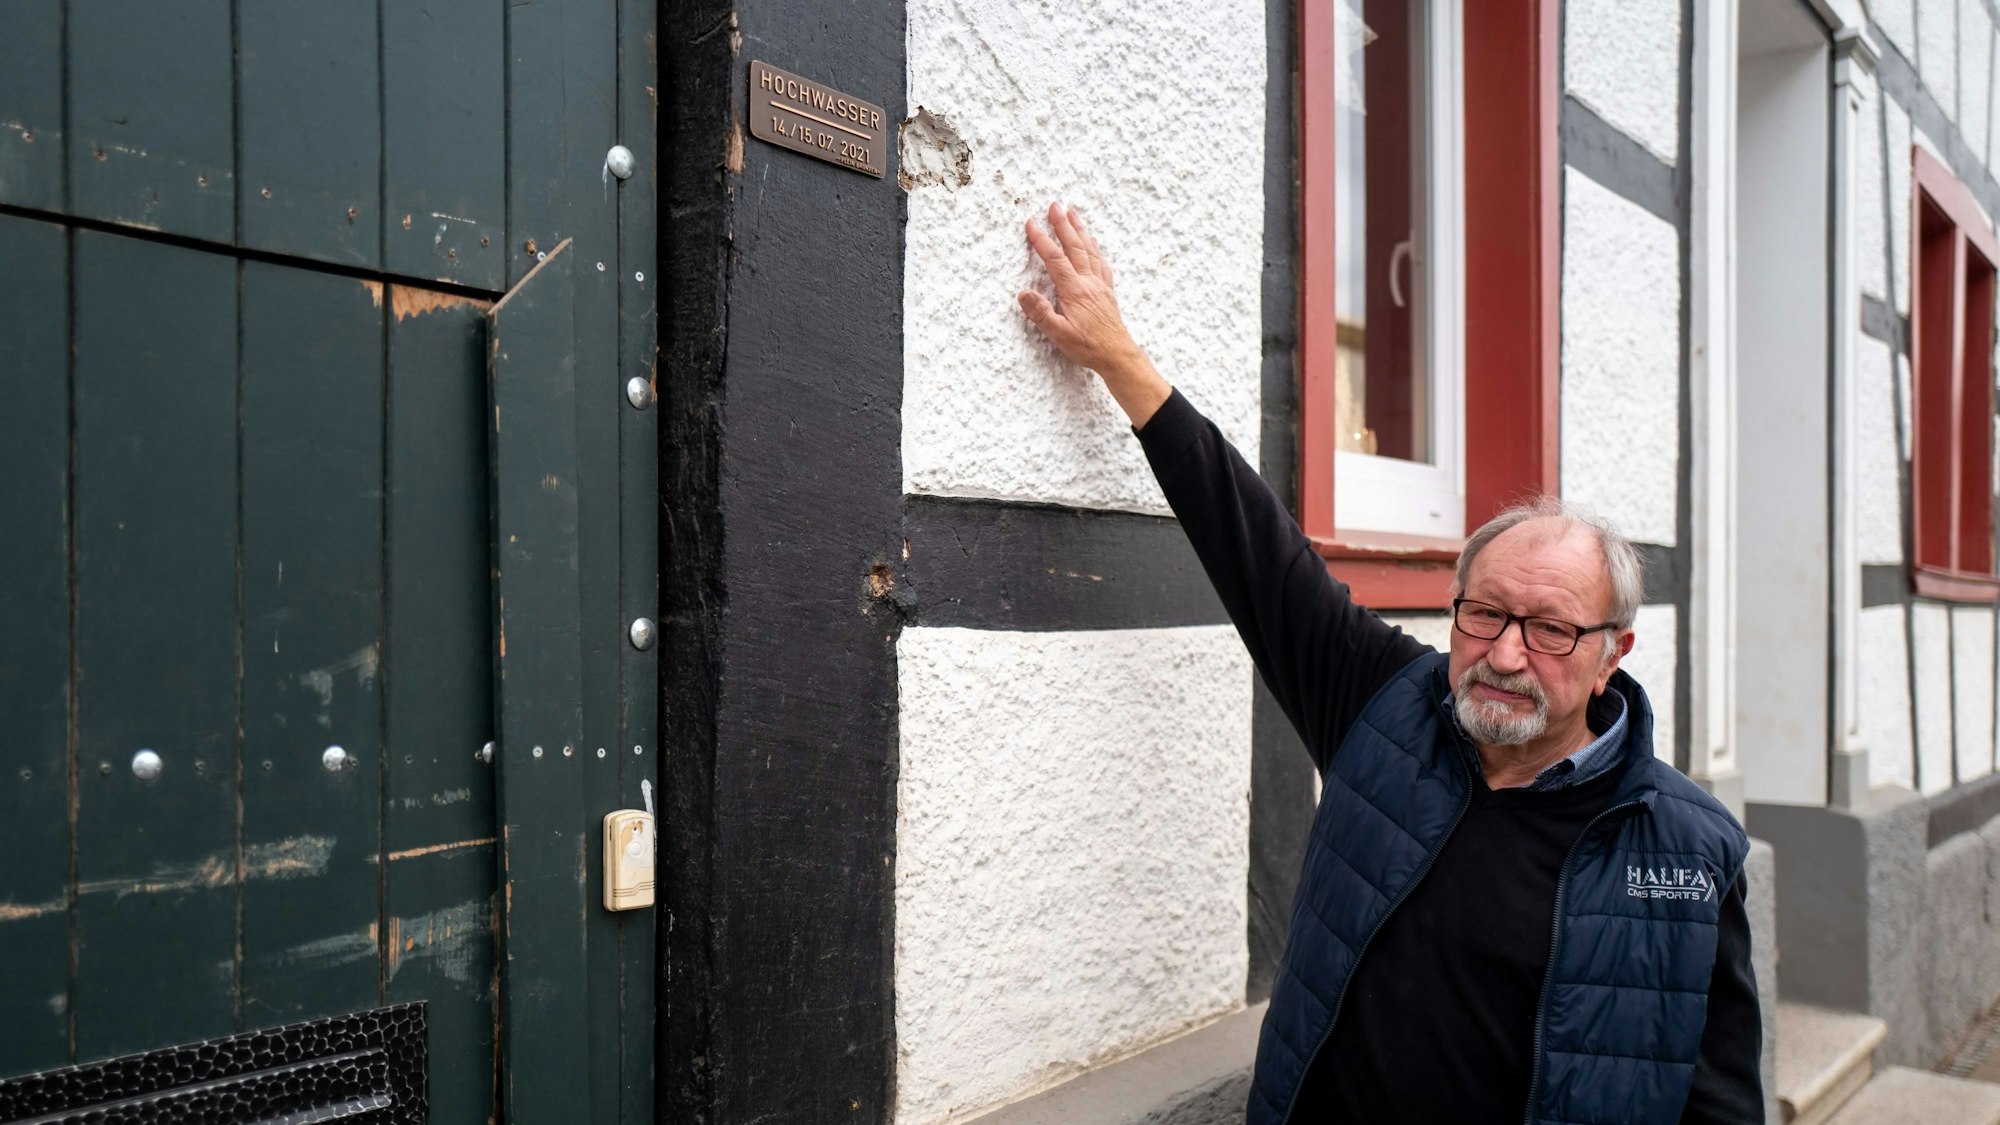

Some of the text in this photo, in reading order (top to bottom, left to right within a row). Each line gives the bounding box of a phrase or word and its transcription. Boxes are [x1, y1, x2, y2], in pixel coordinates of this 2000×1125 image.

[760, 69, 880, 130] HOCHWASSER
[841, 140, 870, 164] 2021
[1627, 887, 1700, 901] CMS SPORTS
